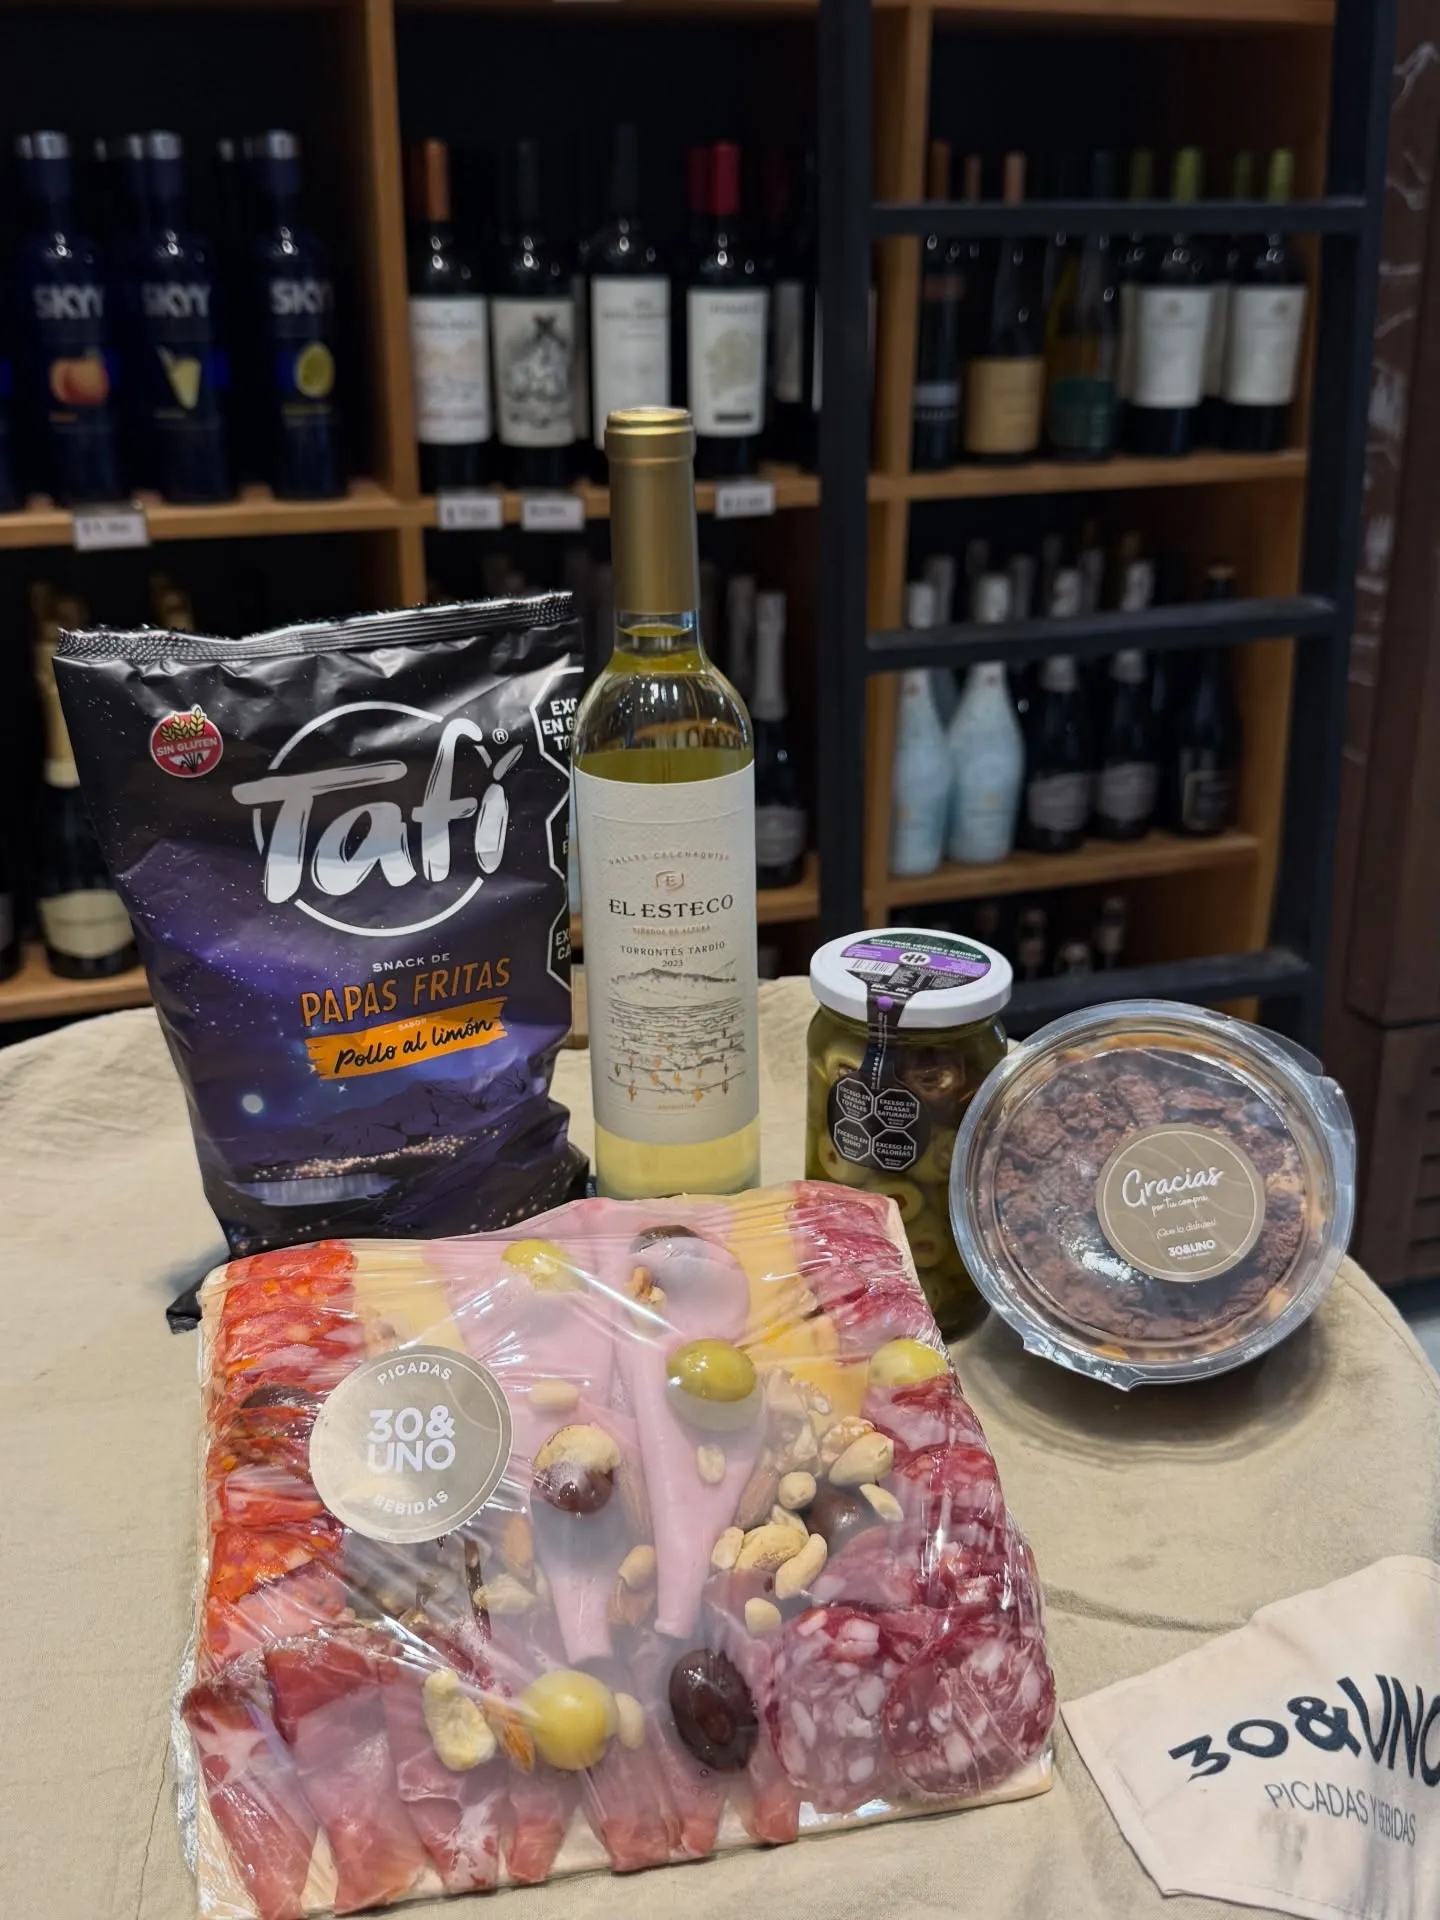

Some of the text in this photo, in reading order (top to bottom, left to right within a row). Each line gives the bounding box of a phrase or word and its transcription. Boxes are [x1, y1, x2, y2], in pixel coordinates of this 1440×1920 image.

[541, 718, 565, 735] EN
[157, 737, 217, 756] SIN GLUTEN
[232, 718, 523, 903] Tafí
[609, 894, 733, 918] EL ESTECO
[620, 941, 725, 956] TORRONTÉS TARDÍO
[372, 952, 450, 973] SNACK DE
[661, 959, 684, 968] 2023
[301, 958, 511, 1027] PAPAS FRITAS
[334, 1016, 493, 1074] Pollo al limón
[875, 1142, 902, 1150] EXCESO
[1122, 1167, 1224, 1207] Gracias
[1168, 1240, 1215, 1257] 30&UNO
[377, 1361, 452, 1385] PICADAS
[367, 1405, 456, 1443] 30&
[367, 1439, 456, 1475] UNO
[373, 1490, 449, 1516] BEBIDAS
[1264, 1780, 1369, 1825] PICADAS
